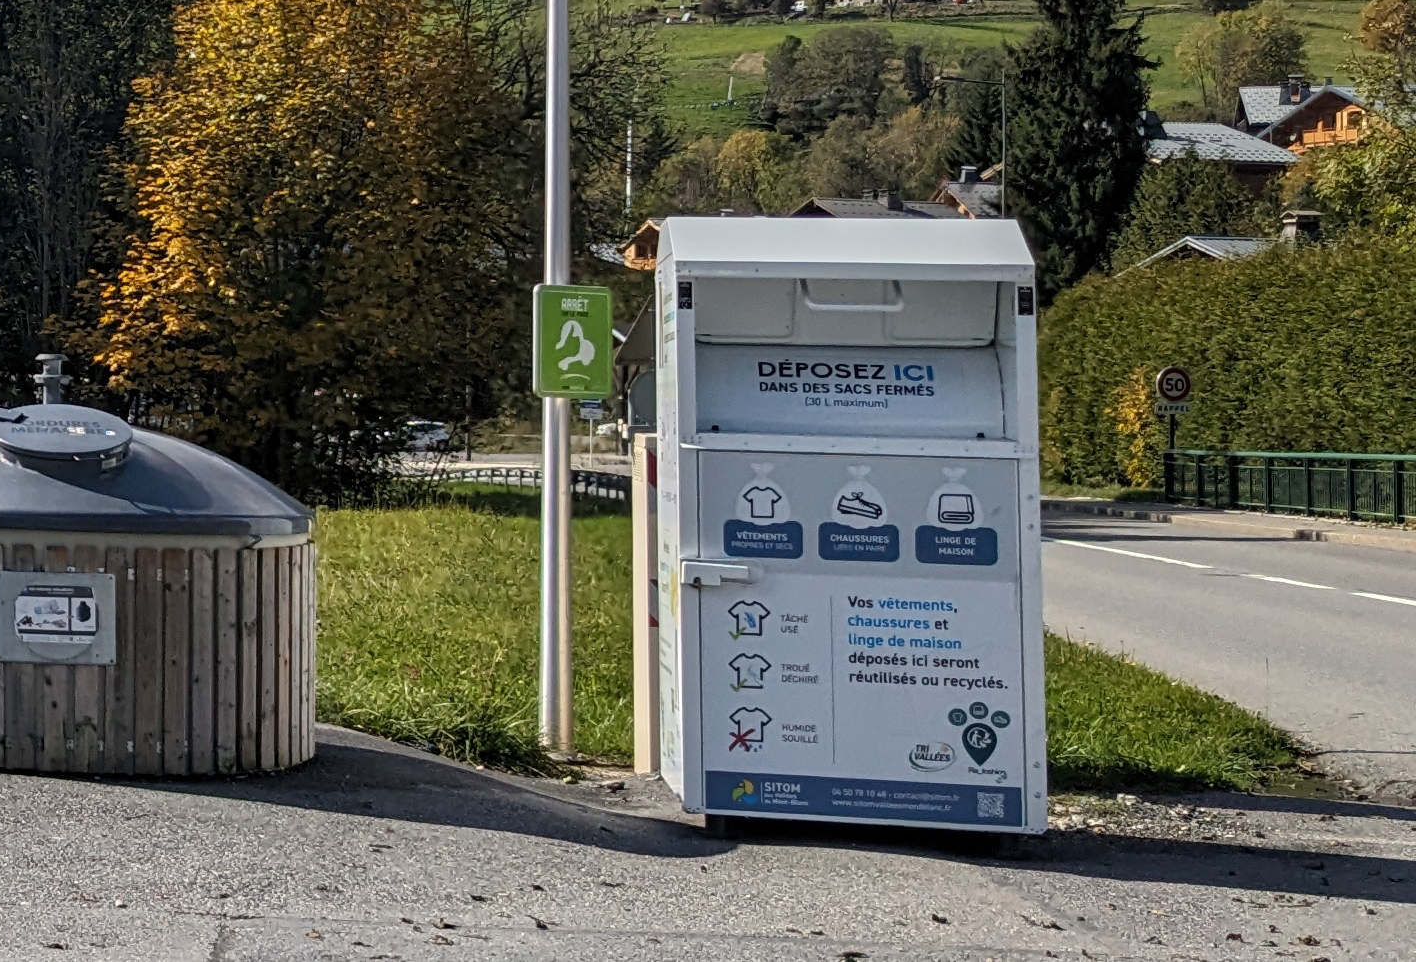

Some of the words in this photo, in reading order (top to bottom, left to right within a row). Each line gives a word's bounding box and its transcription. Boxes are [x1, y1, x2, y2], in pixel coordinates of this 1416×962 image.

[758, 359, 886, 380] DÉPOSEZ
[893, 364, 934, 382] ICI
[759, 381, 798, 393] DANS
[802, 383, 830, 394] DES
[834, 383, 872, 395] SACS
[876, 384, 935, 397] FERMÉS
[1165, 378, 1185, 392] 50
[804, 396, 821, 407] (30
[824, 397, 831, 407] L
[834, 398, 888, 409] maximum)
[735, 531, 788, 542] VÊTEMENTS
[829, 534, 890, 544] CHAUSSURES
[935, 536, 961, 545] LINGE
[964, 537, 977, 546] DE
[938, 547, 974, 556] MAISON
[847, 595, 874, 609] Vos
[878, 597, 958, 613] vêtements,
[847, 615, 930, 629] chaussures
[934, 619, 949, 631] et
[780, 625, 799, 634] USÉ
[848, 633, 884, 648] linge
[887, 635, 905, 647] de
[909, 636, 962, 649] maison
[848, 651, 908, 667] déposés
[912, 654, 928, 667] ici
[932, 657, 980, 669] seront
[780, 663, 811, 673] TROUÉ
[780, 674, 819, 684] DÉCHIRÉ
[849, 670, 917, 685] réutilisés
[921, 676, 939, 686] ou
[943, 675, 1009, 690] recyclés.
[781, 724, 817, 733] HUMIDE
[781, 734, 819, 744] SOUILLÉ
[915, 743, 931, 753] TRI
[914, 751, 952, 763] VALLÉES
[764, 781, 801, 793] SITOM
